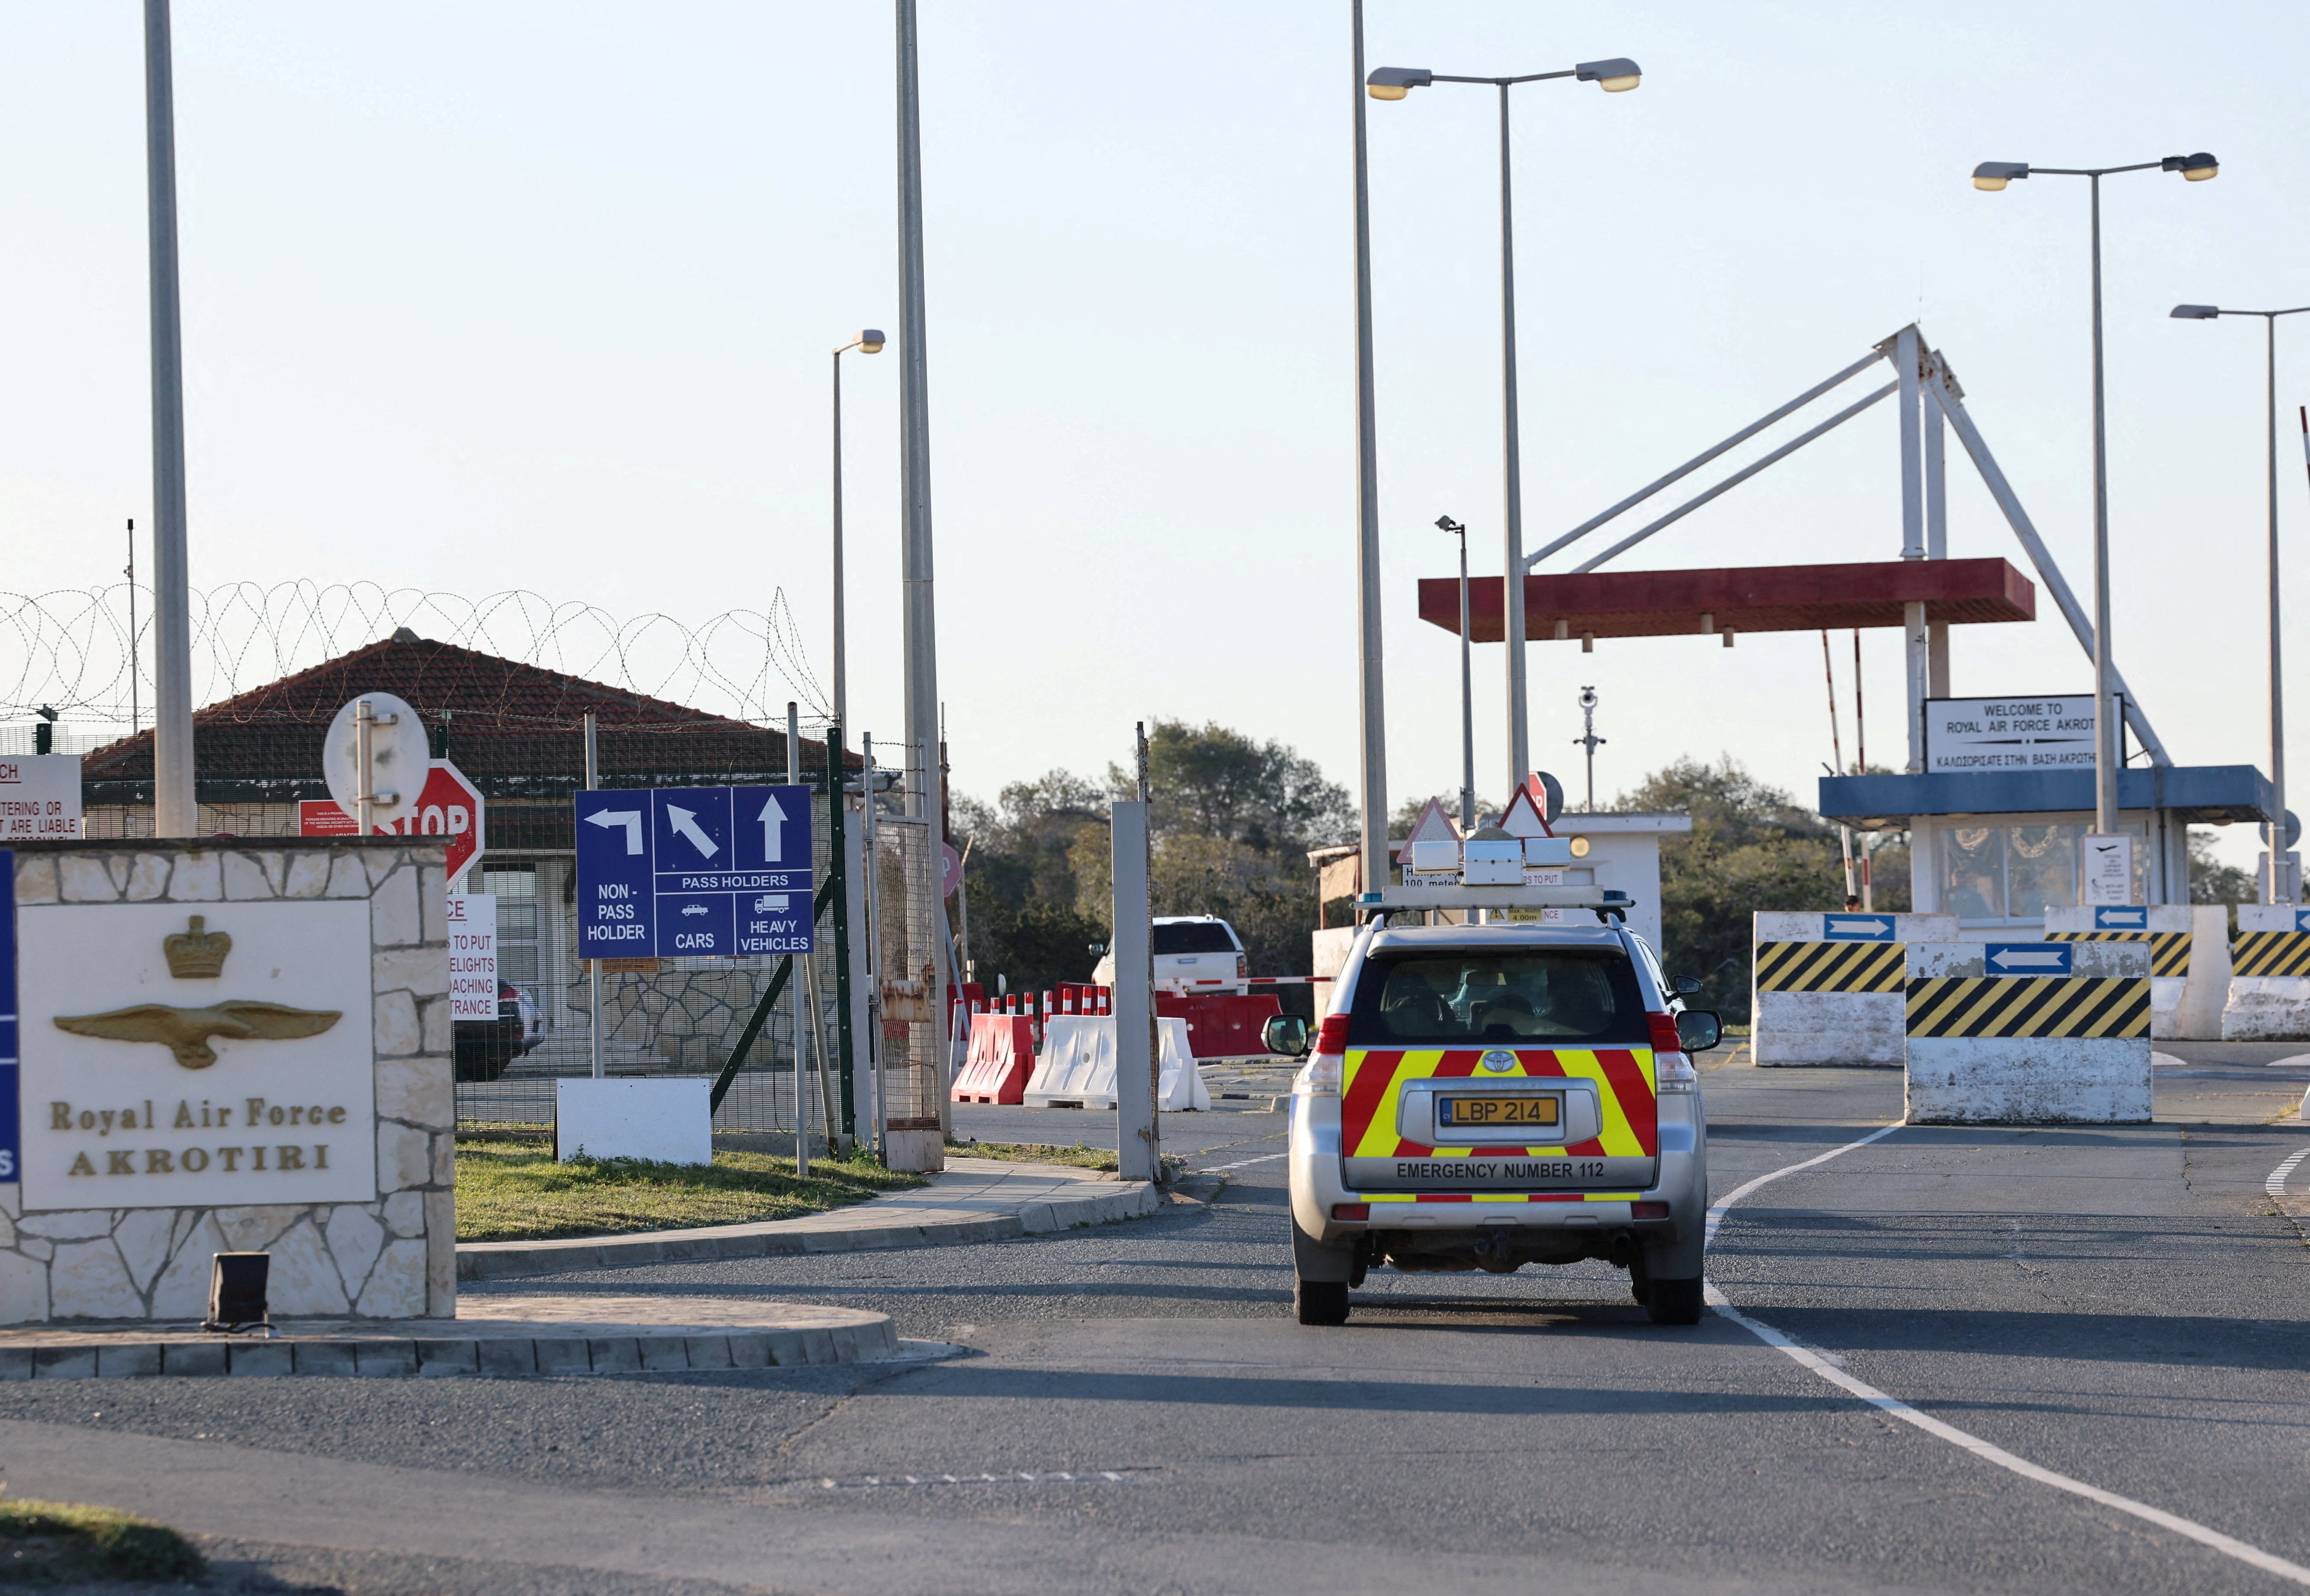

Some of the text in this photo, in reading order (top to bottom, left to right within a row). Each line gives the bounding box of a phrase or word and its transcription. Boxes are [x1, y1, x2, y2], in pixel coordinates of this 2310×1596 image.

[1984, 703, 2062, 716] WELCOME TO
[1947, 721, 1982, 734] ROYAL
[1988, 721, 2007, 732] AIR
[2013, 720, 2050, 732] FORCE
[46, 801, 61, 815] OR
[10, 819, 32, 833] ARE
[39, 819, 75, 833] LIABLE
[683, 875, 789, 888] PASS HOLDERS
[1545, 875, 1558, 883] PUT
[598, 904, 634, 920] PASS
[588, 925, 645, 940] HOLDER
[751, 920, 797, 933] HEAVY
[454, 935, 468, 950] TO
[471, 935, 491, 950] PUT
[675, 933, 714, 949] CARS
[741, 937, 808, 951] VEHICLES
[50, 1098, 346, 1137] Royal Air Force
[1456, 1102, 1541, 1121] LBP 214
[67, 1144, 329, 1176] AKROTIRI
[1397, 1162, 1604, 1178] EMERGENCY NUMBER 112
